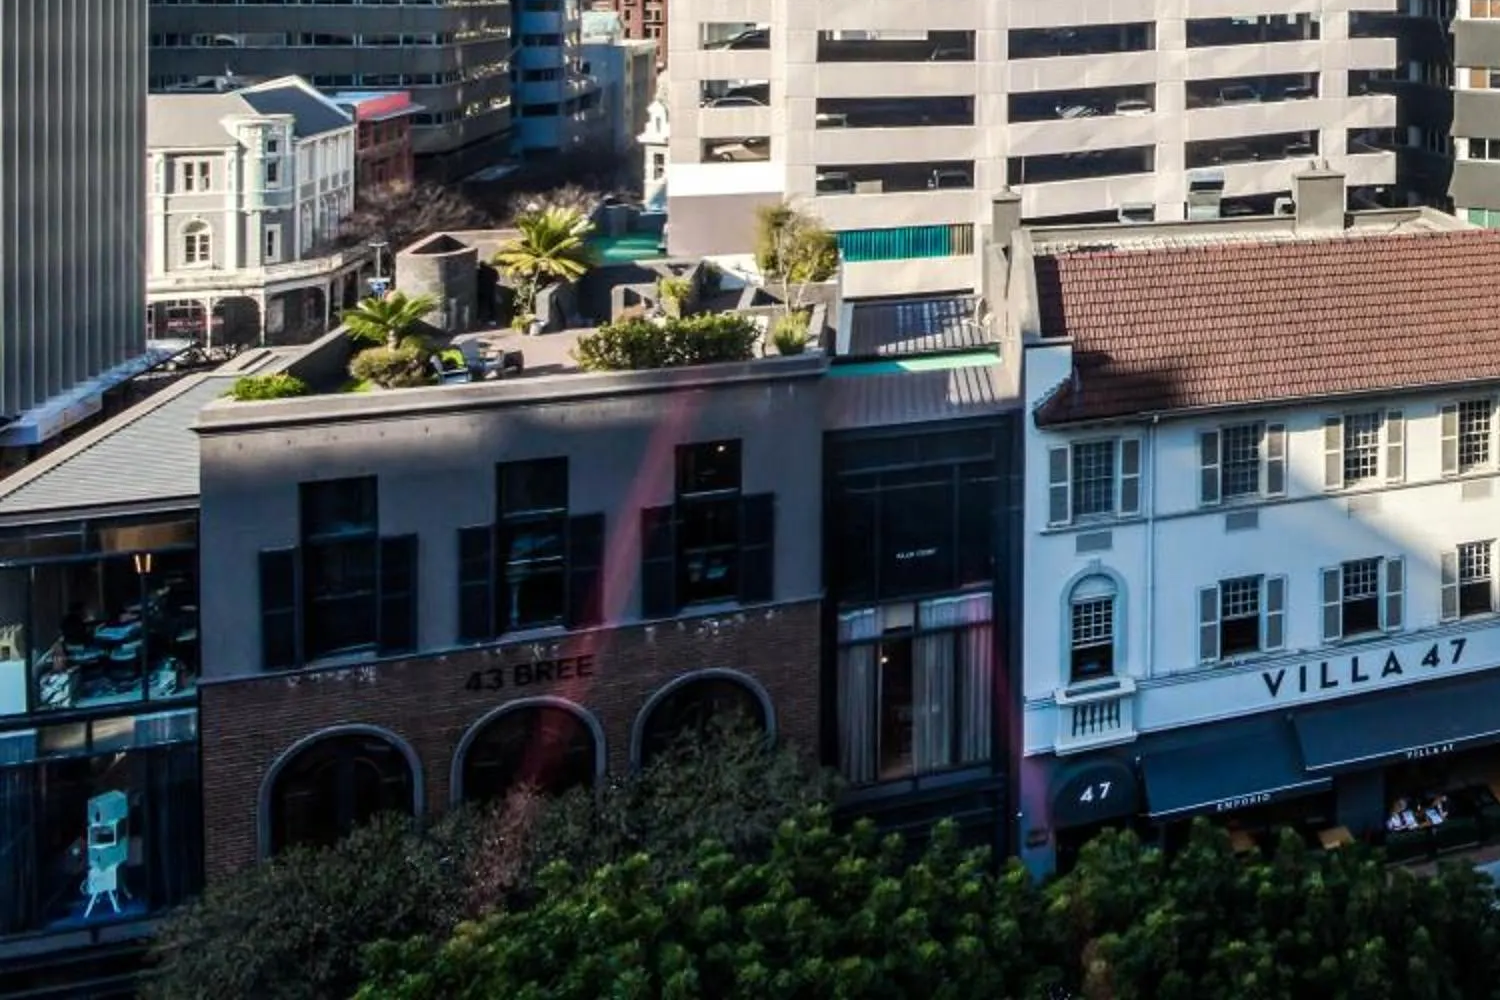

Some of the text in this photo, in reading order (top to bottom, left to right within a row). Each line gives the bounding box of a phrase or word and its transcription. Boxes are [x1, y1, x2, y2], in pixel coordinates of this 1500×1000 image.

[465, 654, 595, 691] 43 BREE
[1262, 638, 1467, 698] VILLA 47
[1080, 781, 1111, 802] 47
